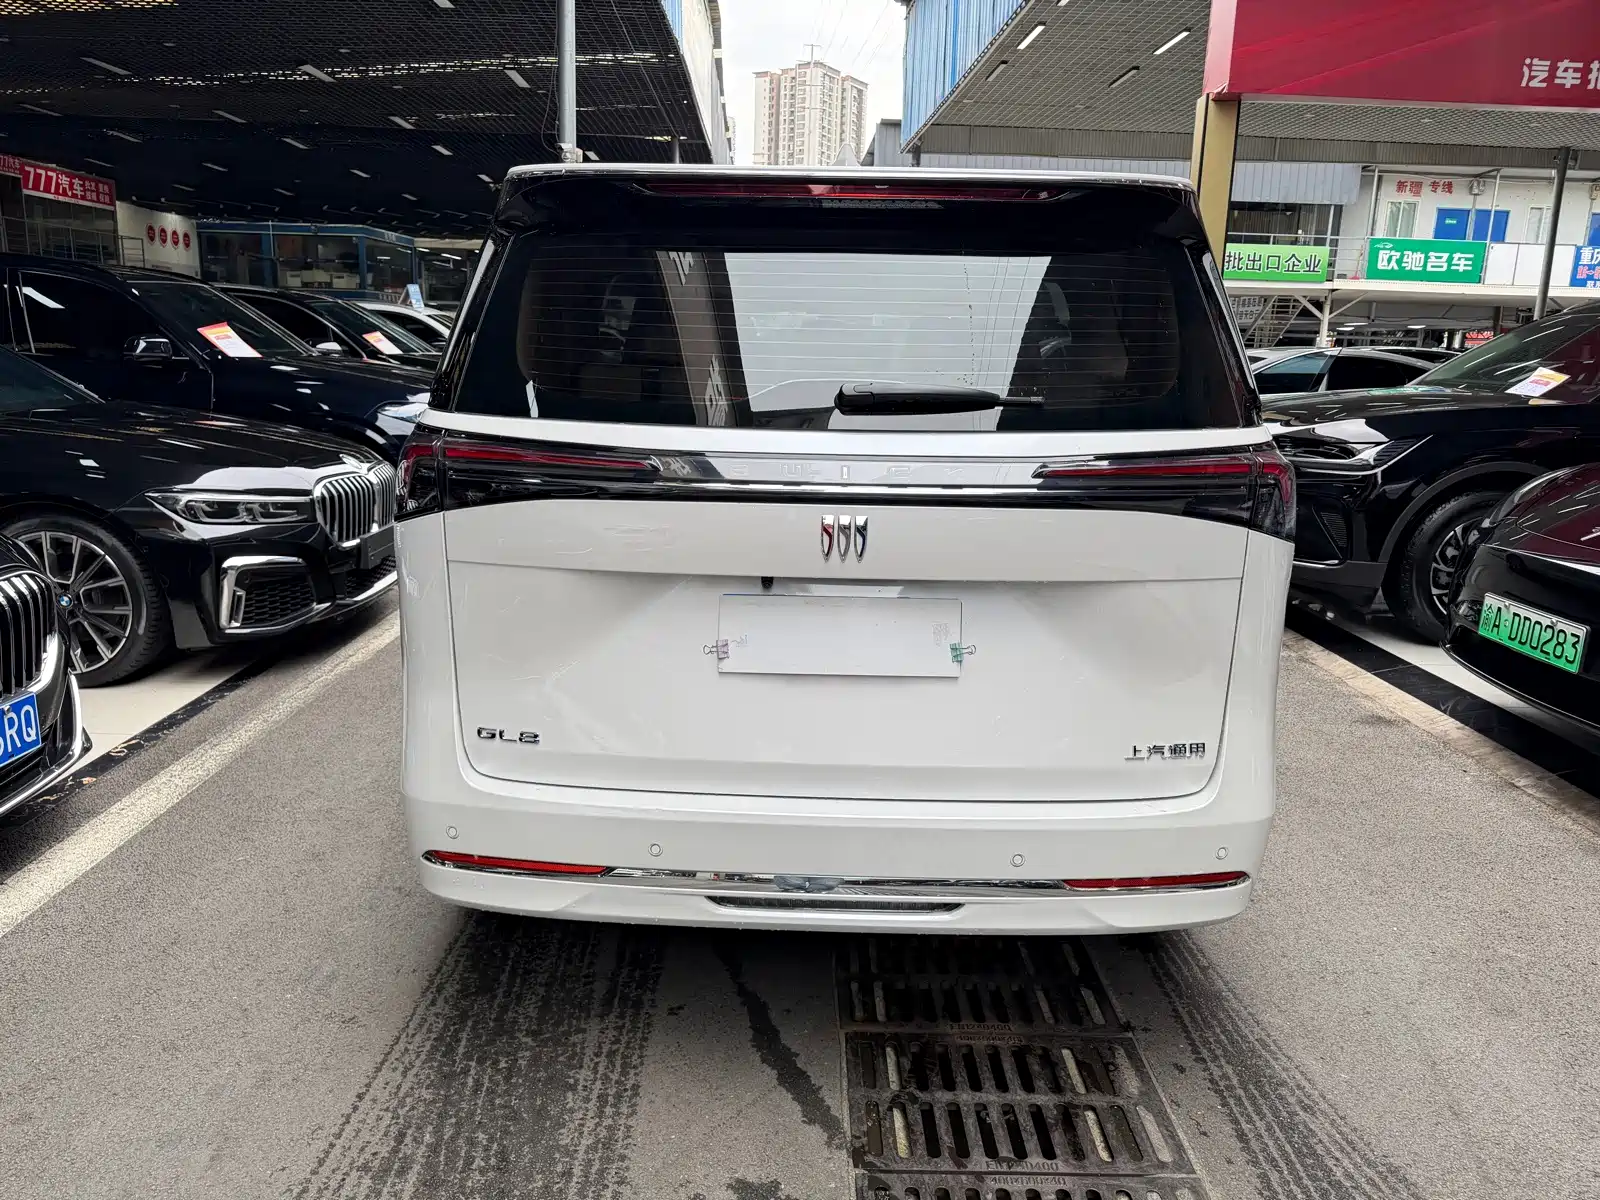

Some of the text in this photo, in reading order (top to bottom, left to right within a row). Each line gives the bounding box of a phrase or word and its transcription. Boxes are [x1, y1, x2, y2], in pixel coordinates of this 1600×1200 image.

[24, 166, 85, 198] 777汽车
[1396, 180, 1454, 197] 新疆 专线
[1225, 251, 1321, 273] 批出口企业
[1377, 250, 1474, 272] 欧驰名车
[0, 704, 37, 757] RQ
[477, 726, 540, 745] GL8
[1123, 742, 1206, 761] 上汽通用
